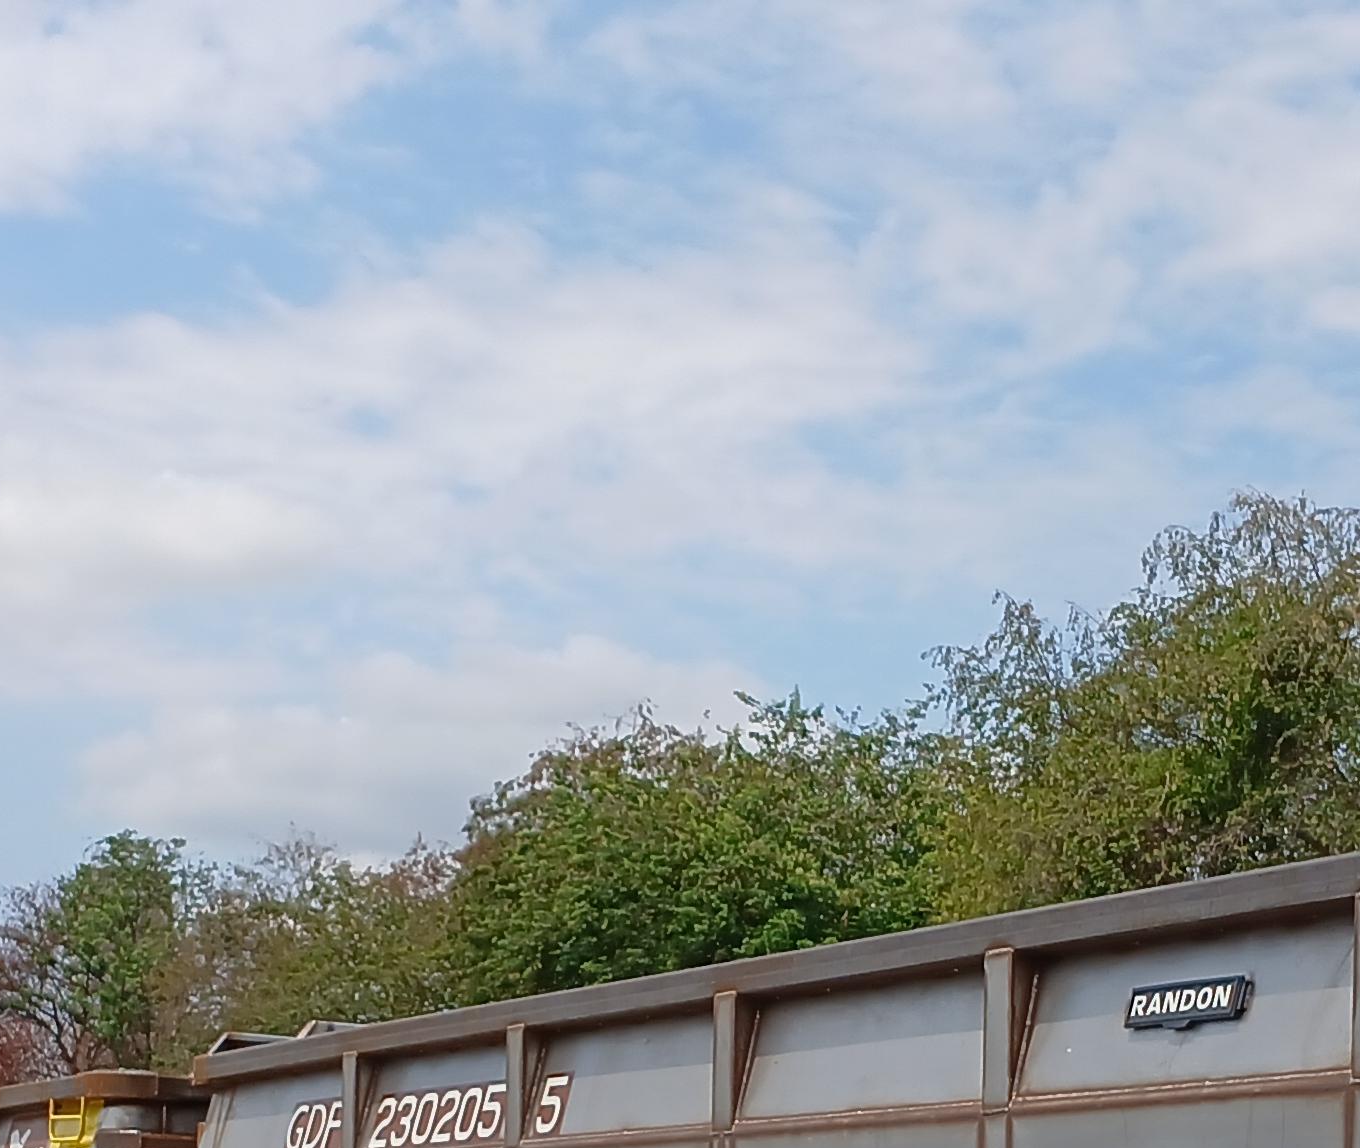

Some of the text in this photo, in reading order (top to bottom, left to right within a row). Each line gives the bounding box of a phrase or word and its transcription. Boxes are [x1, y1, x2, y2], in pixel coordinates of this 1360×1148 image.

[1130, 984, 1232, 1017] RANDON
[367, 1083, 507, 1148] 230205
[535, 1075, 569, 1134] 5
